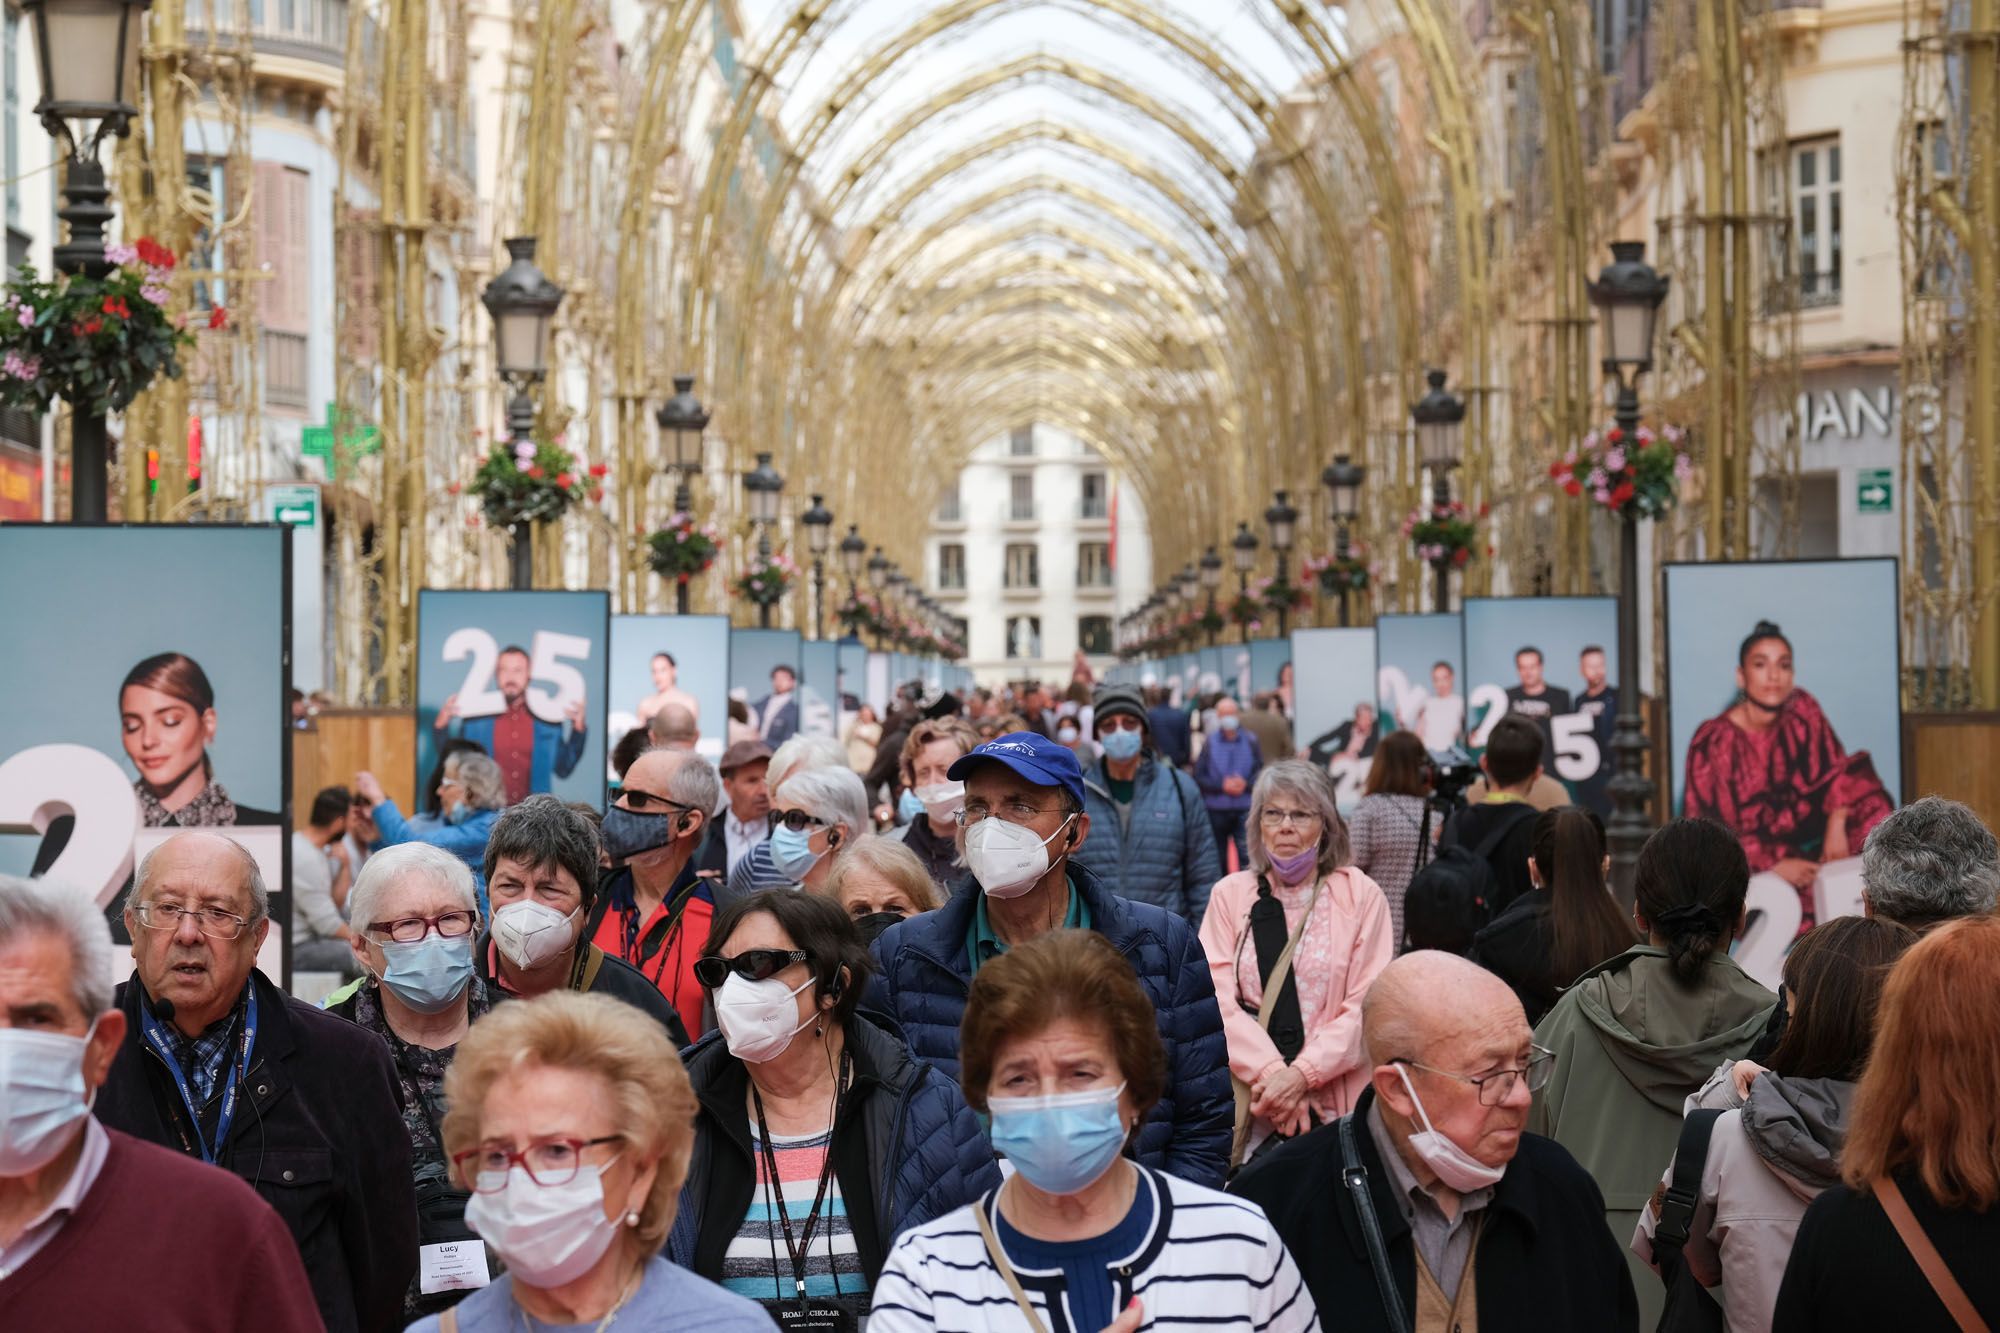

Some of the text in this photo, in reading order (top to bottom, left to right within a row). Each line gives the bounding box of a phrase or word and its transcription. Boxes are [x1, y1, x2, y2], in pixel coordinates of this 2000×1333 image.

[224, 1096, 235, 1117] Allianz
[440, 1245, 458, 1253] Lucy
[782, 1311, 804, 1319] ROAD
